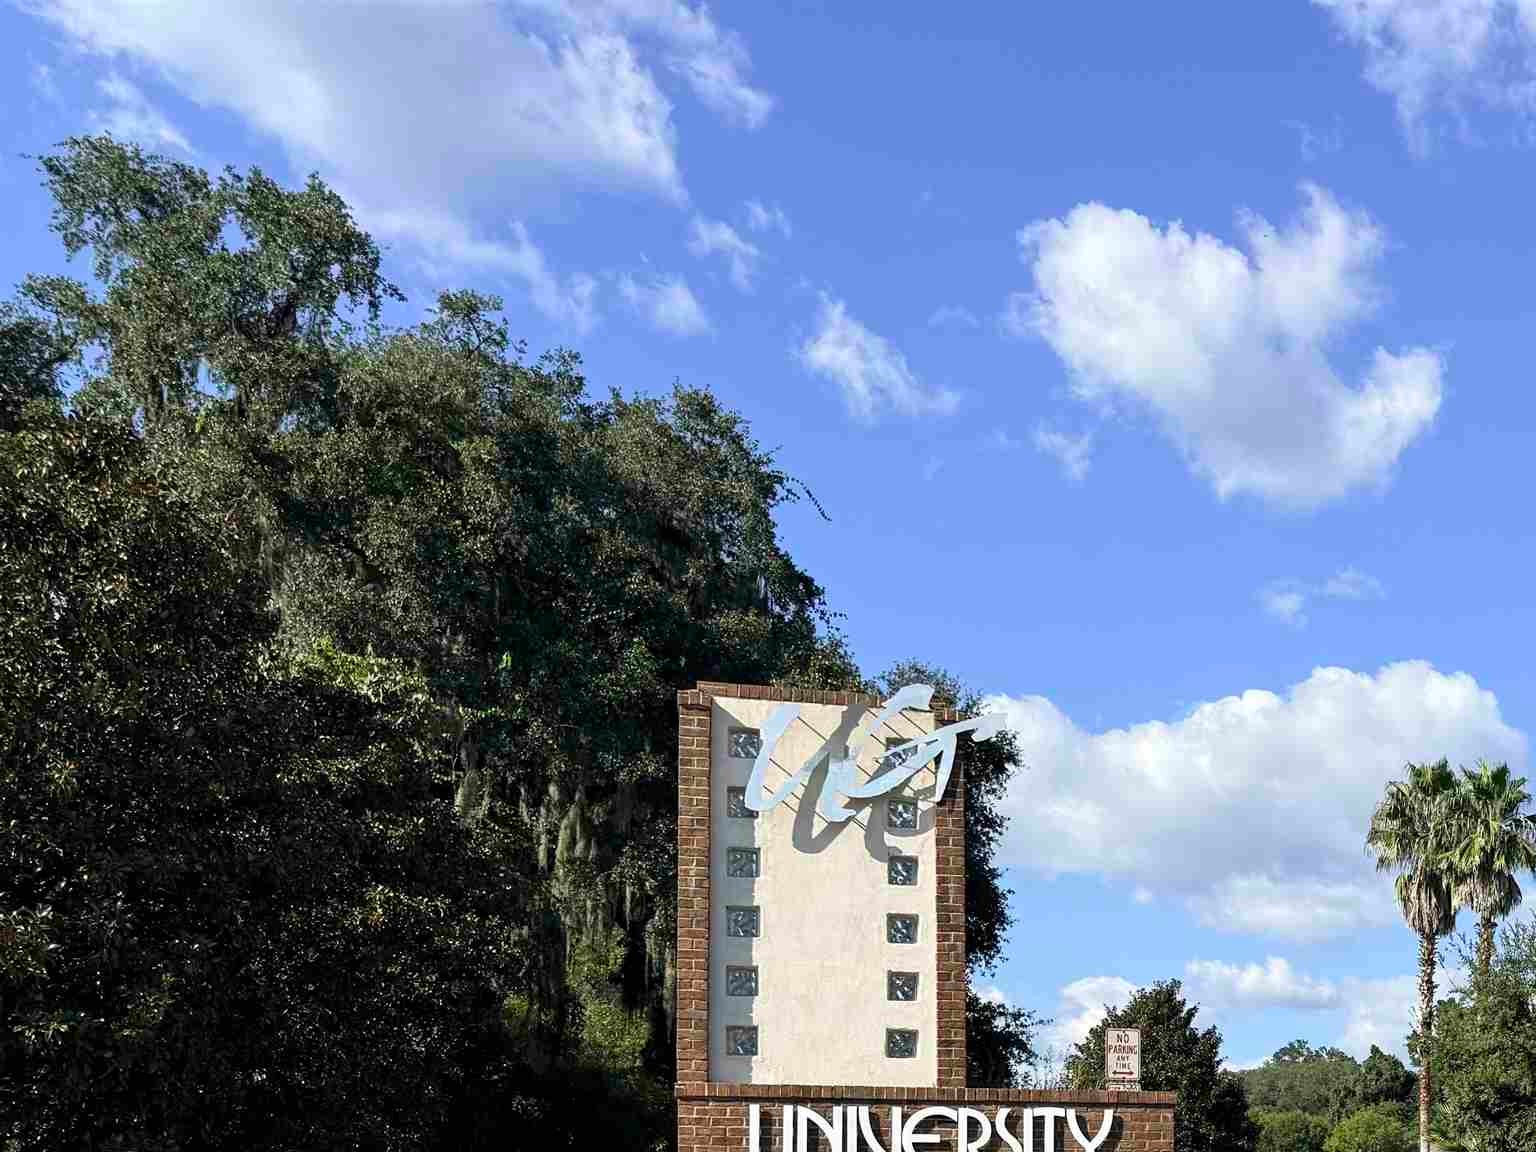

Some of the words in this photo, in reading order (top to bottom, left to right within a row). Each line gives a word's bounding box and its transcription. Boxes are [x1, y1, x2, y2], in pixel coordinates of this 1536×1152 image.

[1116, 1033, 1130, 1044] NO
[1108, 1044, 1138, 1055] PARKING
[1115, 1062, 1132, 1070] TIME
